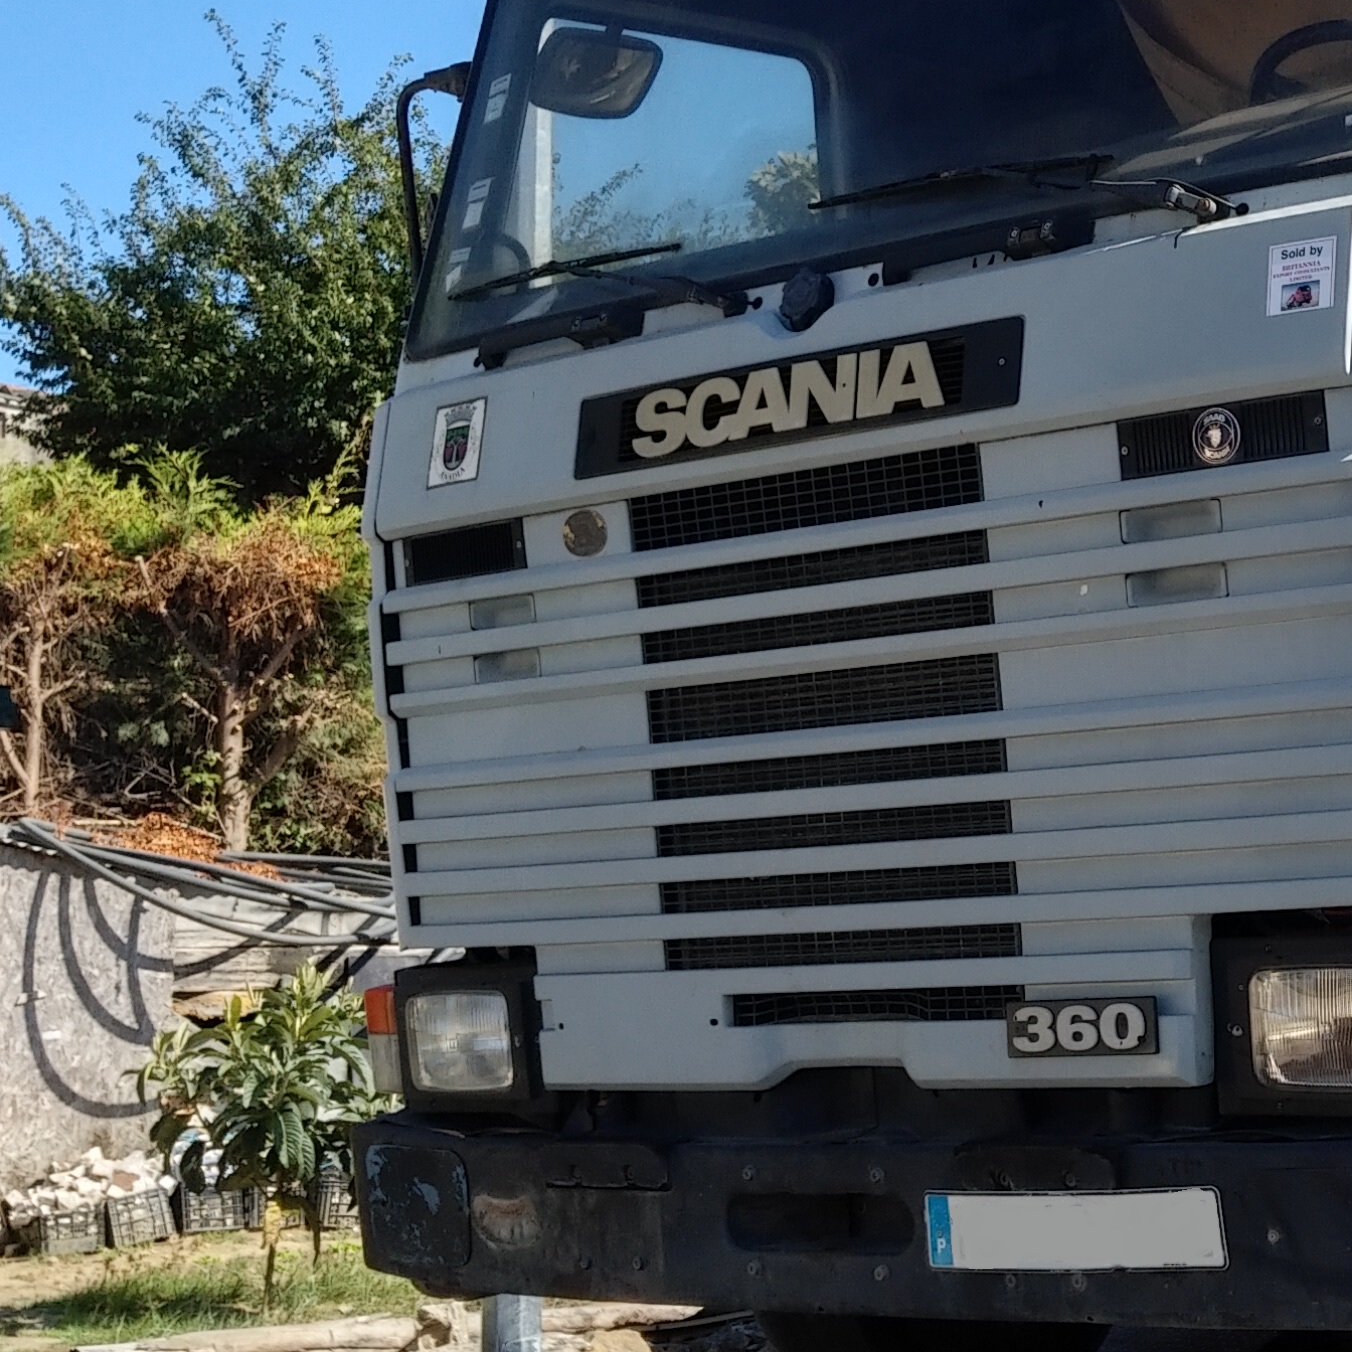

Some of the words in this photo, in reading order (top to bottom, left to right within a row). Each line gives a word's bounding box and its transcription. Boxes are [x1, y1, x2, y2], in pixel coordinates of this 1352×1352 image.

[1281, 247, 1306, 260] Sold
[1310, 246, 1323, 257] by
[1282, 260, 1321, 271] BRITANNIA
[632, 341, 945, 458] SCANIA
[1012, 1002, 1146, 1053] 360
[937, 1238, 947, 1254] P
